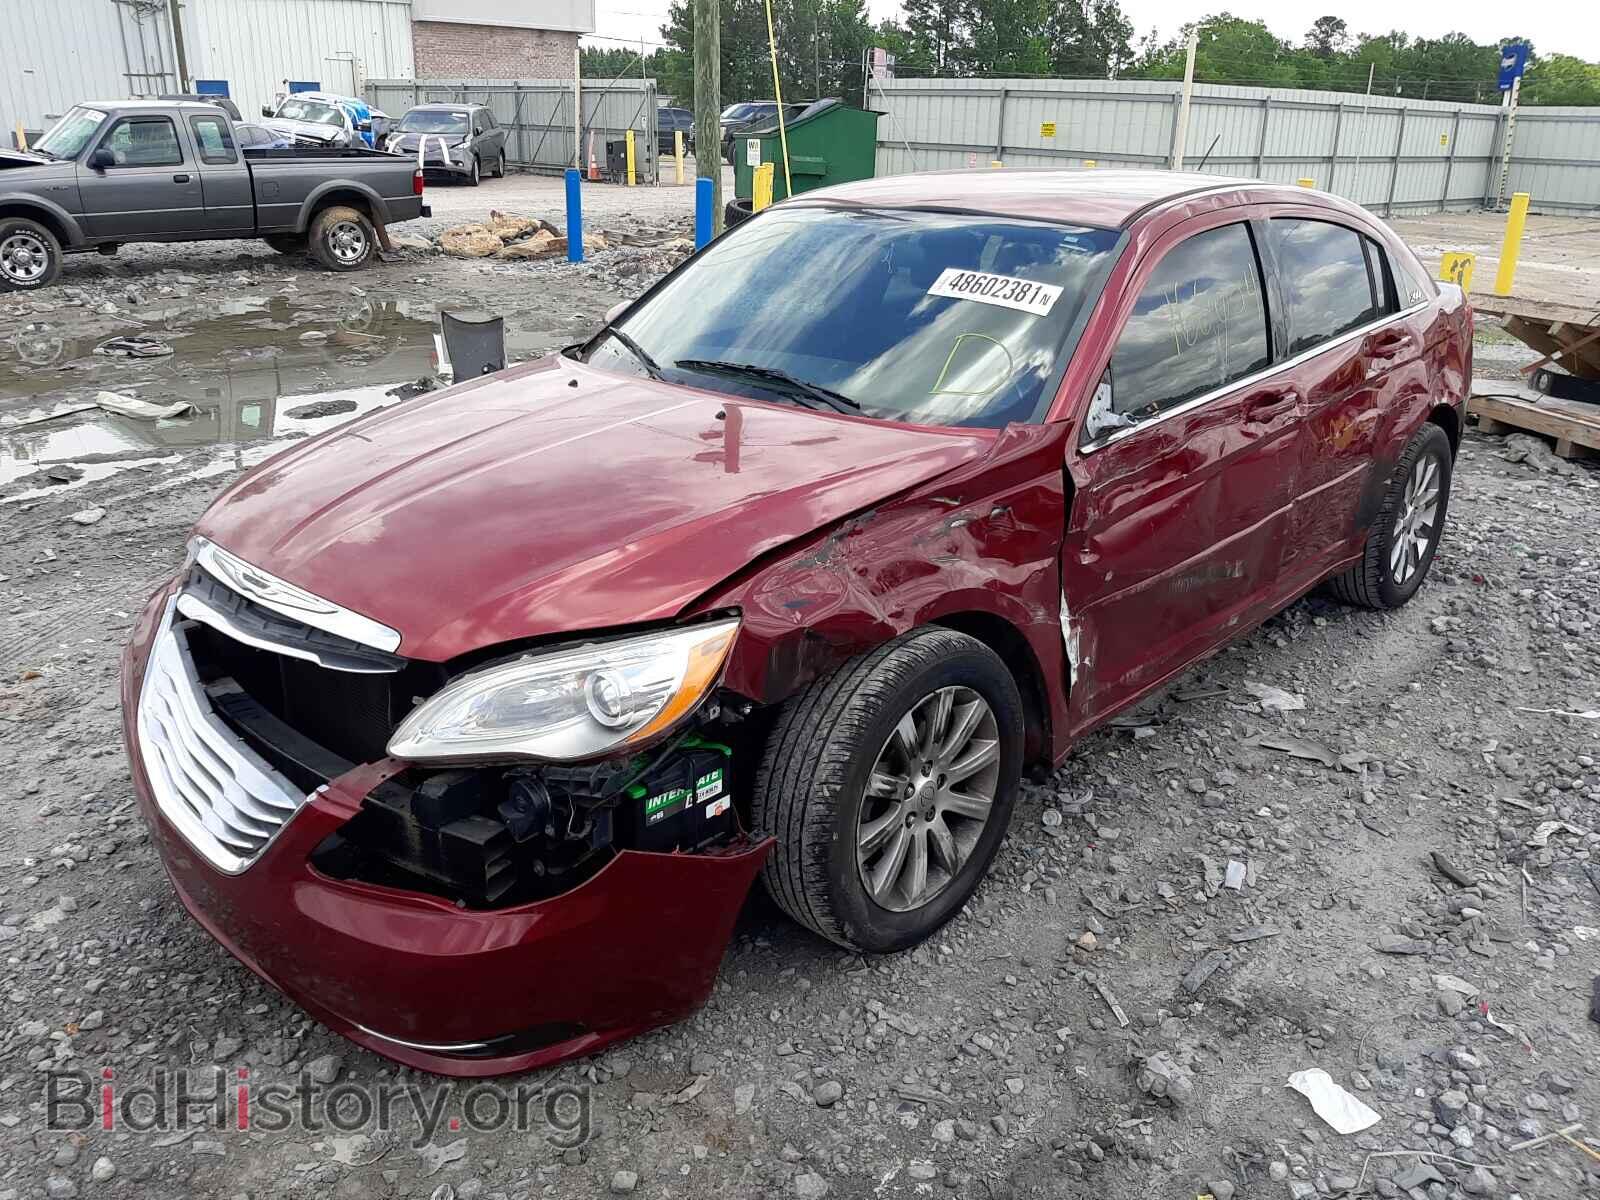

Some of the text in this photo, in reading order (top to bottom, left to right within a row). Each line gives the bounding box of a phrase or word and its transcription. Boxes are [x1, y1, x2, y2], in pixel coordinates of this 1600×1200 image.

[948, 272, 1042, 304] 48602381
[928, 333, 1013, 395] D
[647, 770, 719, 810] INTERATE
